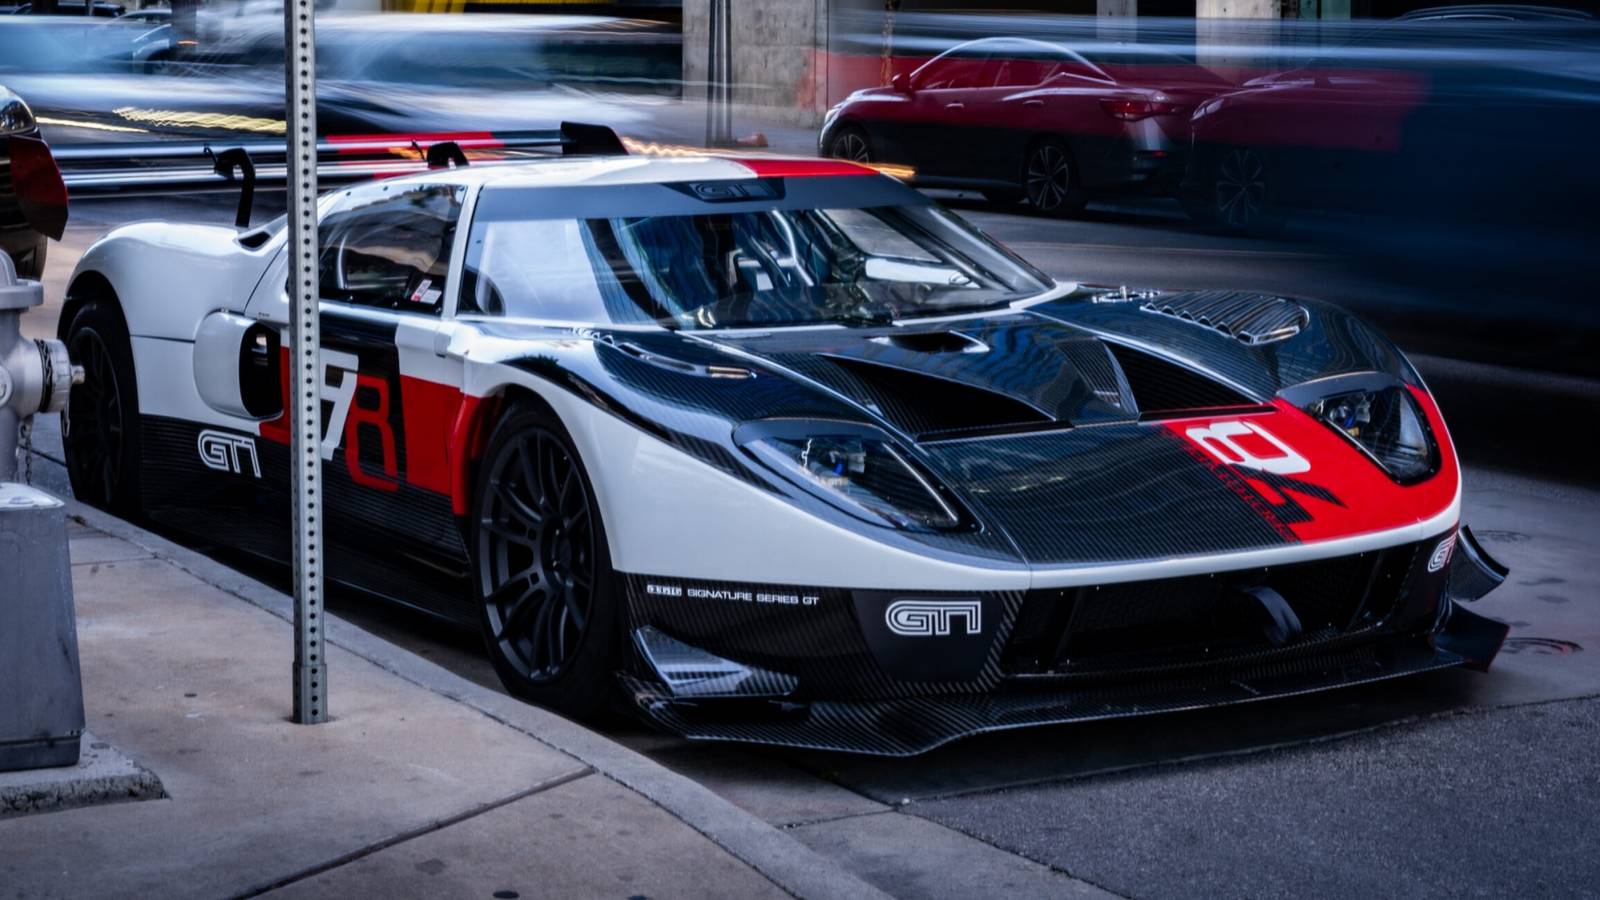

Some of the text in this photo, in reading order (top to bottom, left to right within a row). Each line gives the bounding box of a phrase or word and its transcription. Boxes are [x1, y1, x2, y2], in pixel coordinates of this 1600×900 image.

[687, 588, 753, 601] SIGNATURE
[756, 593, 799, 604] SERIES
[802, 596, 820, 605] GT
